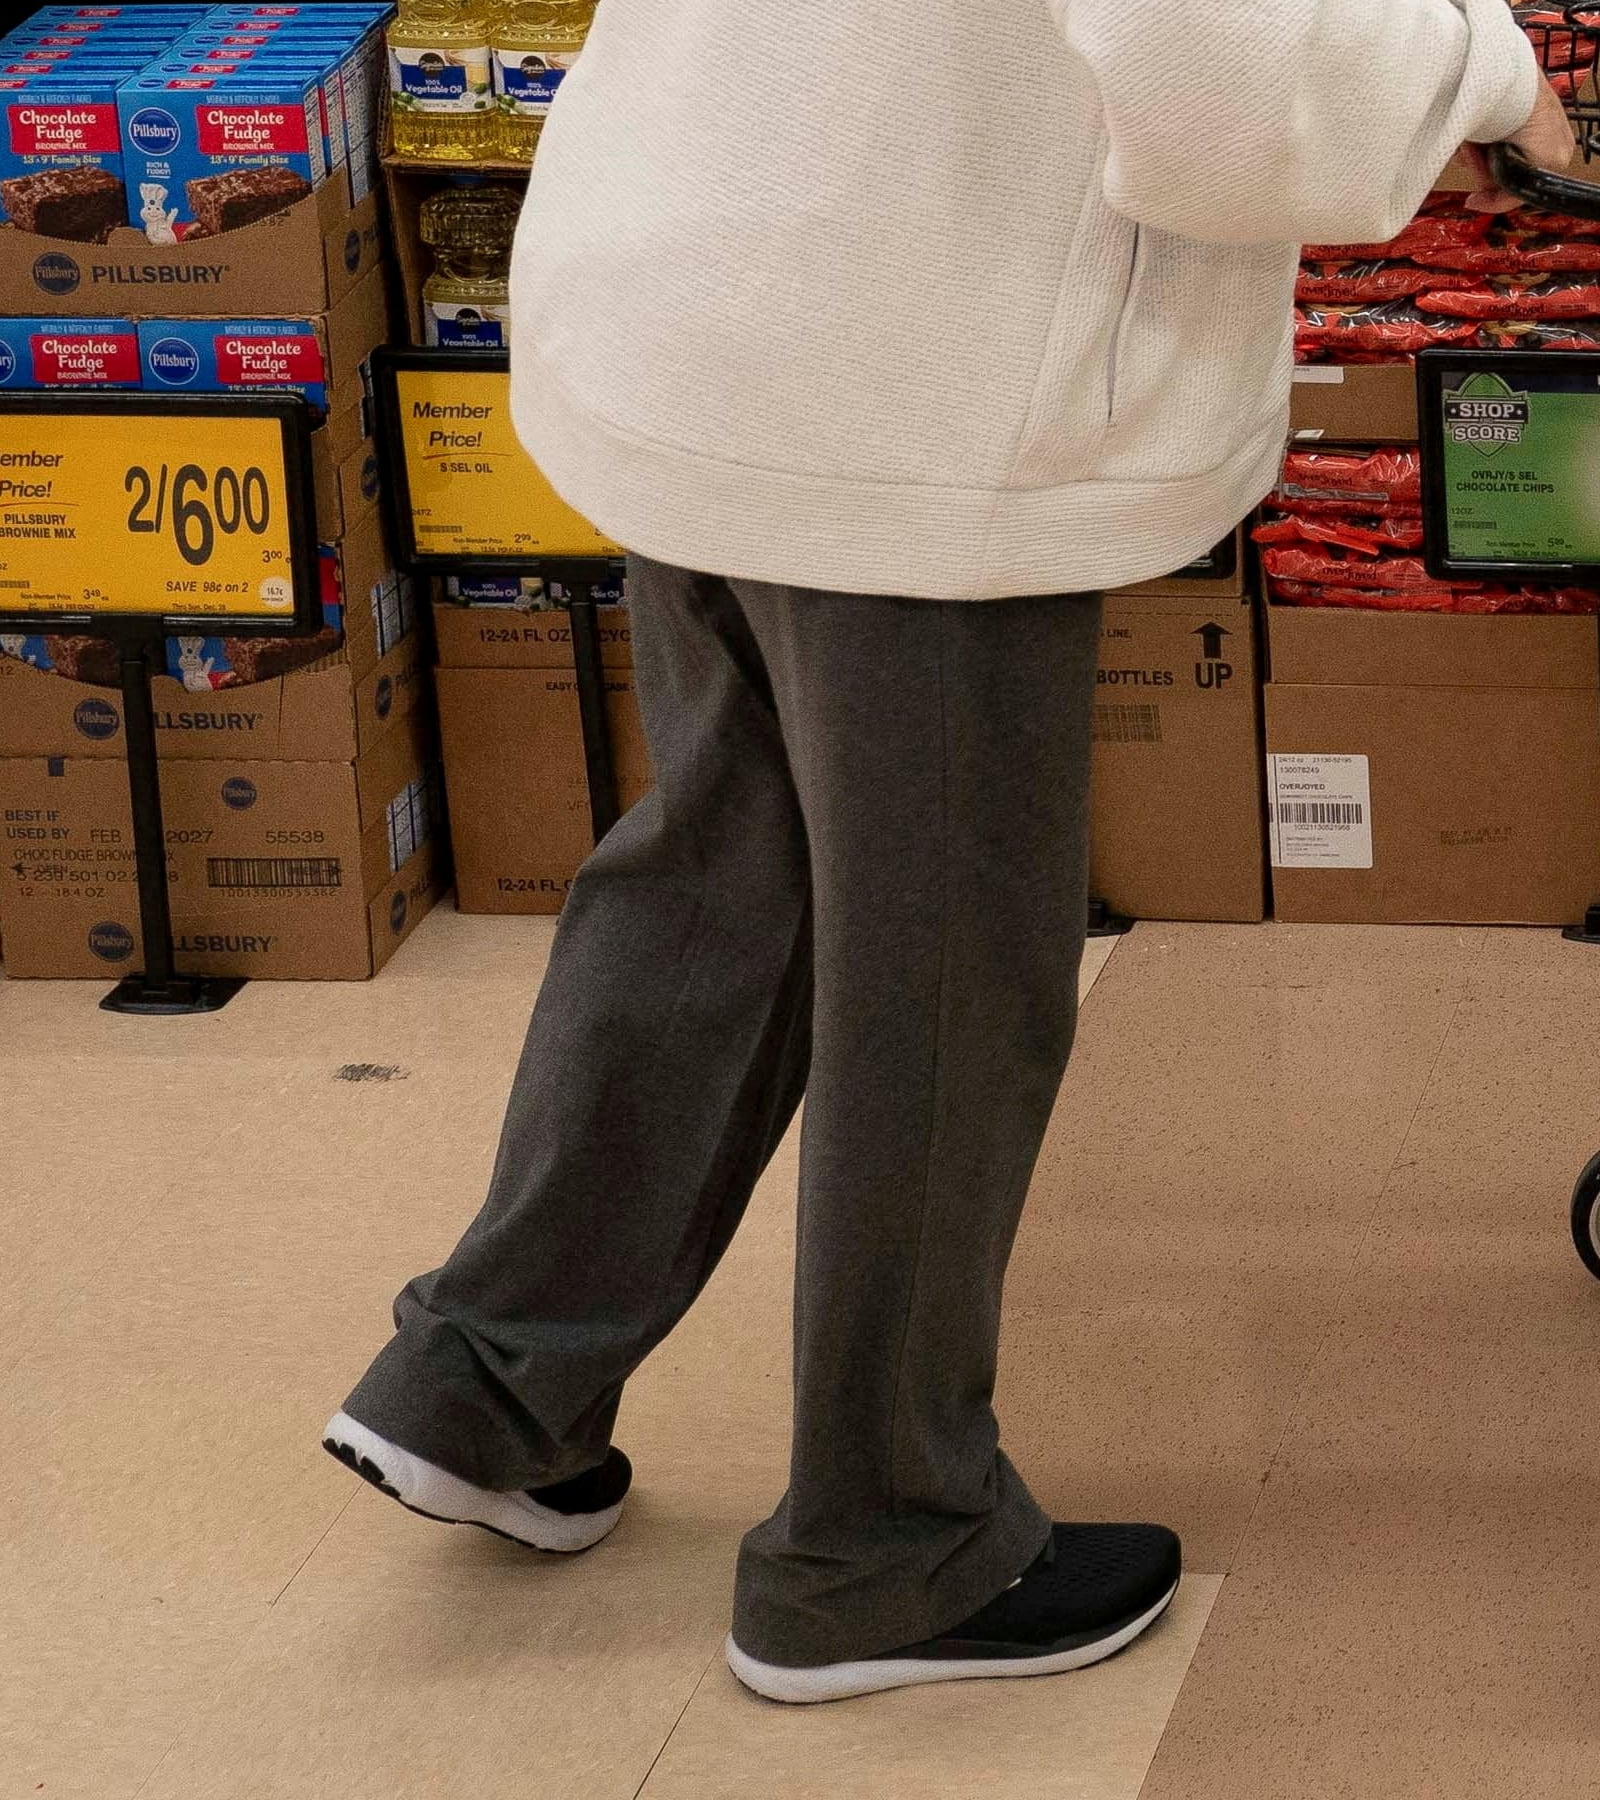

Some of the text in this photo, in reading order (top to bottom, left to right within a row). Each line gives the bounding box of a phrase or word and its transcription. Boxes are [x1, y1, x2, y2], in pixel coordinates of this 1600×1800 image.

[207, 111, 284, 125] Chocolate
[215, 126, 263, 147] Fudge
[91, 265, 224, 283] PILLSBURY
[1459, 403, 1516, 419] SHOP
[1453, 426, 1520, 442] SCORE
[1456, 482, 1554, 493] CHOCOLATE CHIPS
[4, 514, 66, 525] PILLSBURY
[1096, 670, 1174, 686] BOTTLES
[1194, 662, 1232, 689] UP
[6, 828, 70, 839] USED BY
[265, 830, 325, 844] 55538
